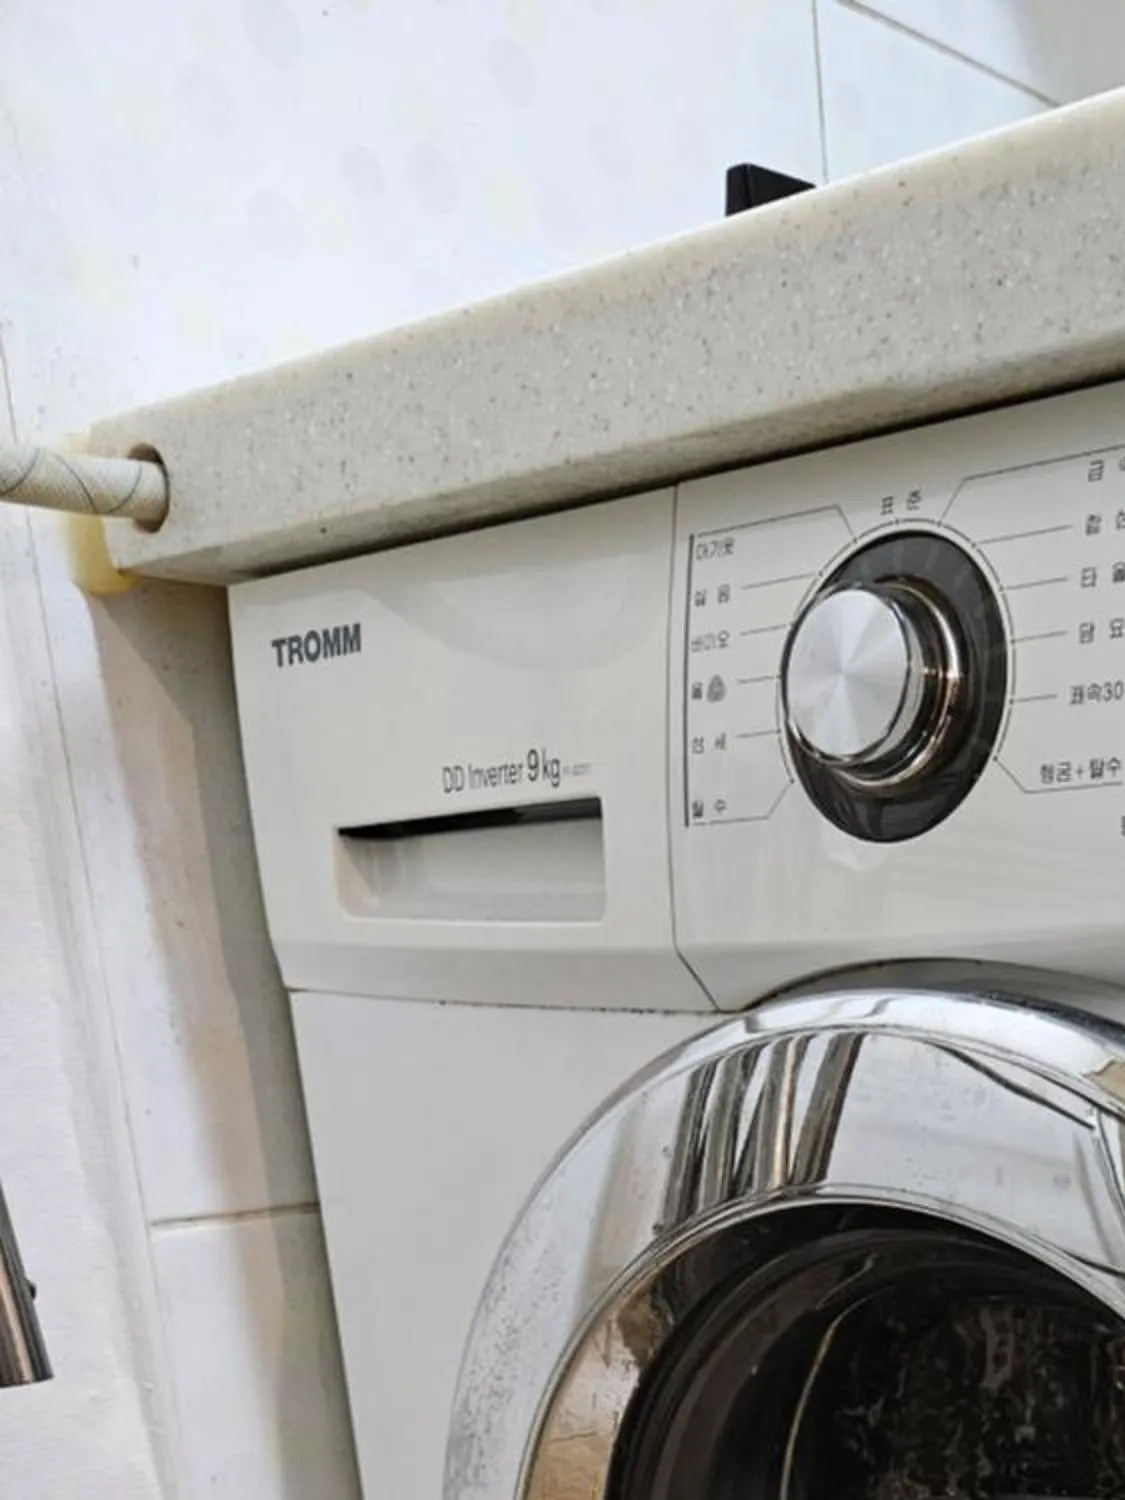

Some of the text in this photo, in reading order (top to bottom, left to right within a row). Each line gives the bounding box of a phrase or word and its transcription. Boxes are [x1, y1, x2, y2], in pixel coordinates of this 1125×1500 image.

[271, 622, 362, 668] TROMM
[442, 764, 466, 794] DD
[467, 761, 524, 790] Inverter
